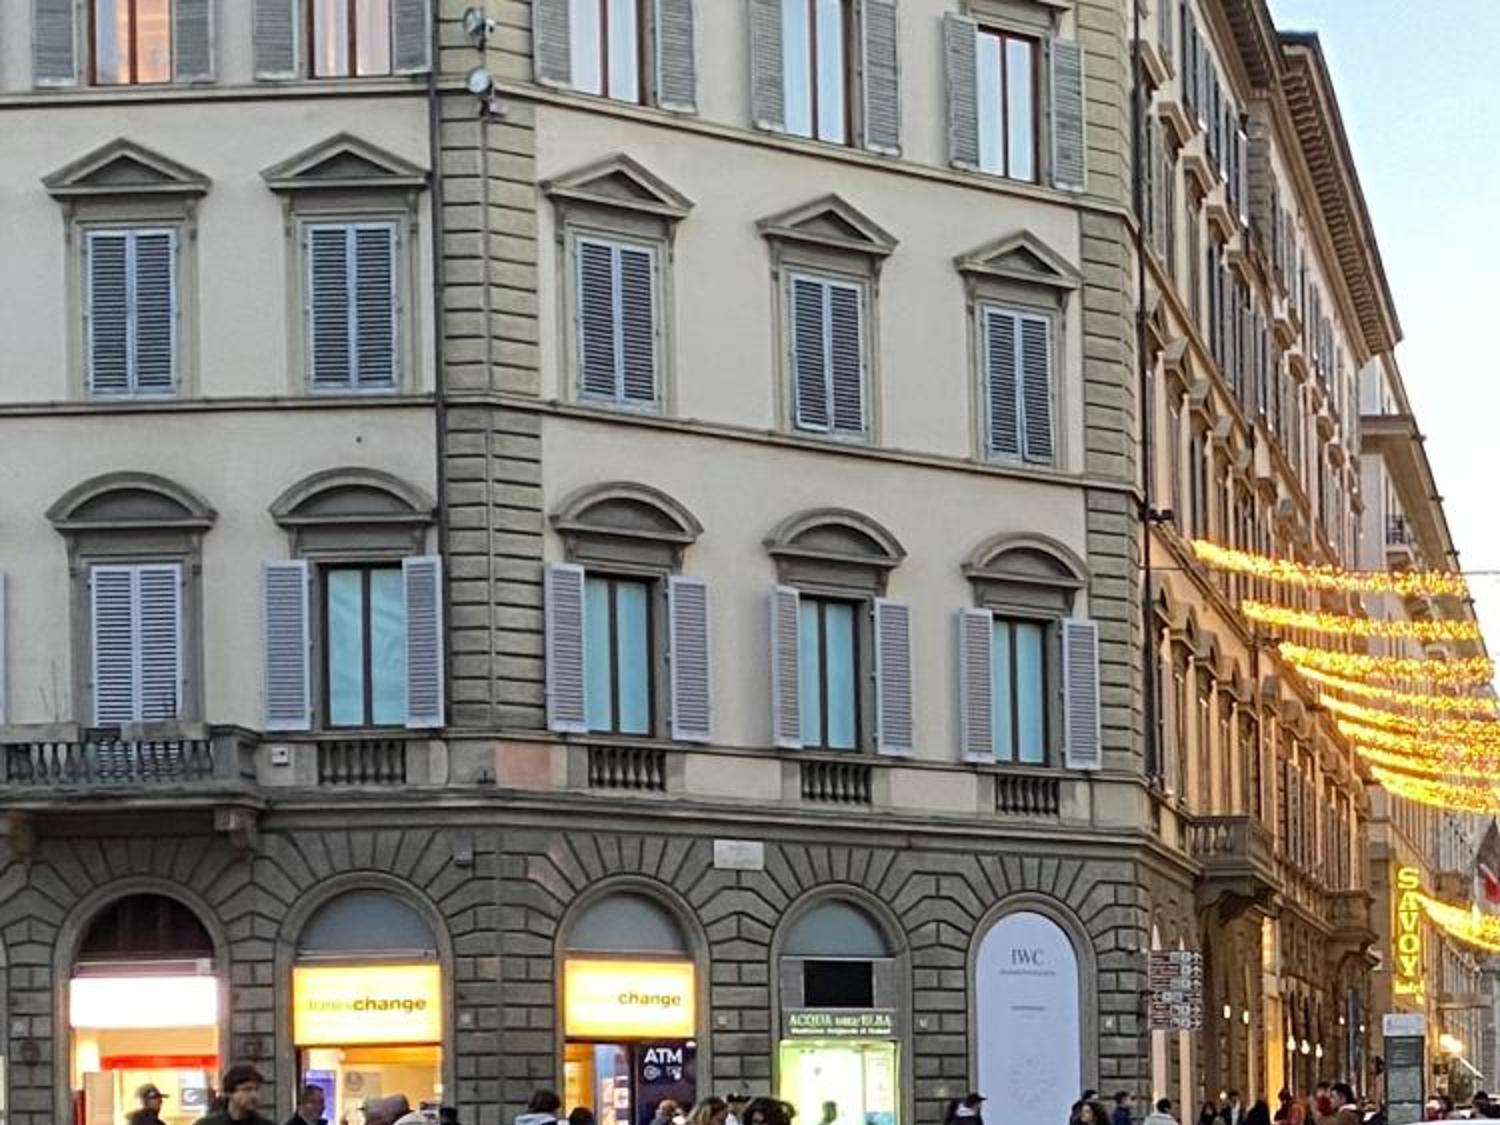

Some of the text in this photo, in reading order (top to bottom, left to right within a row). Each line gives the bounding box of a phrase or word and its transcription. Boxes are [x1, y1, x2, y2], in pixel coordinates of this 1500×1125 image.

[1397, 867, 1420, 977] SAVOY
[1011, 948, 1045, 966] IWC
[643, 1048, 683, 1064] ATM
